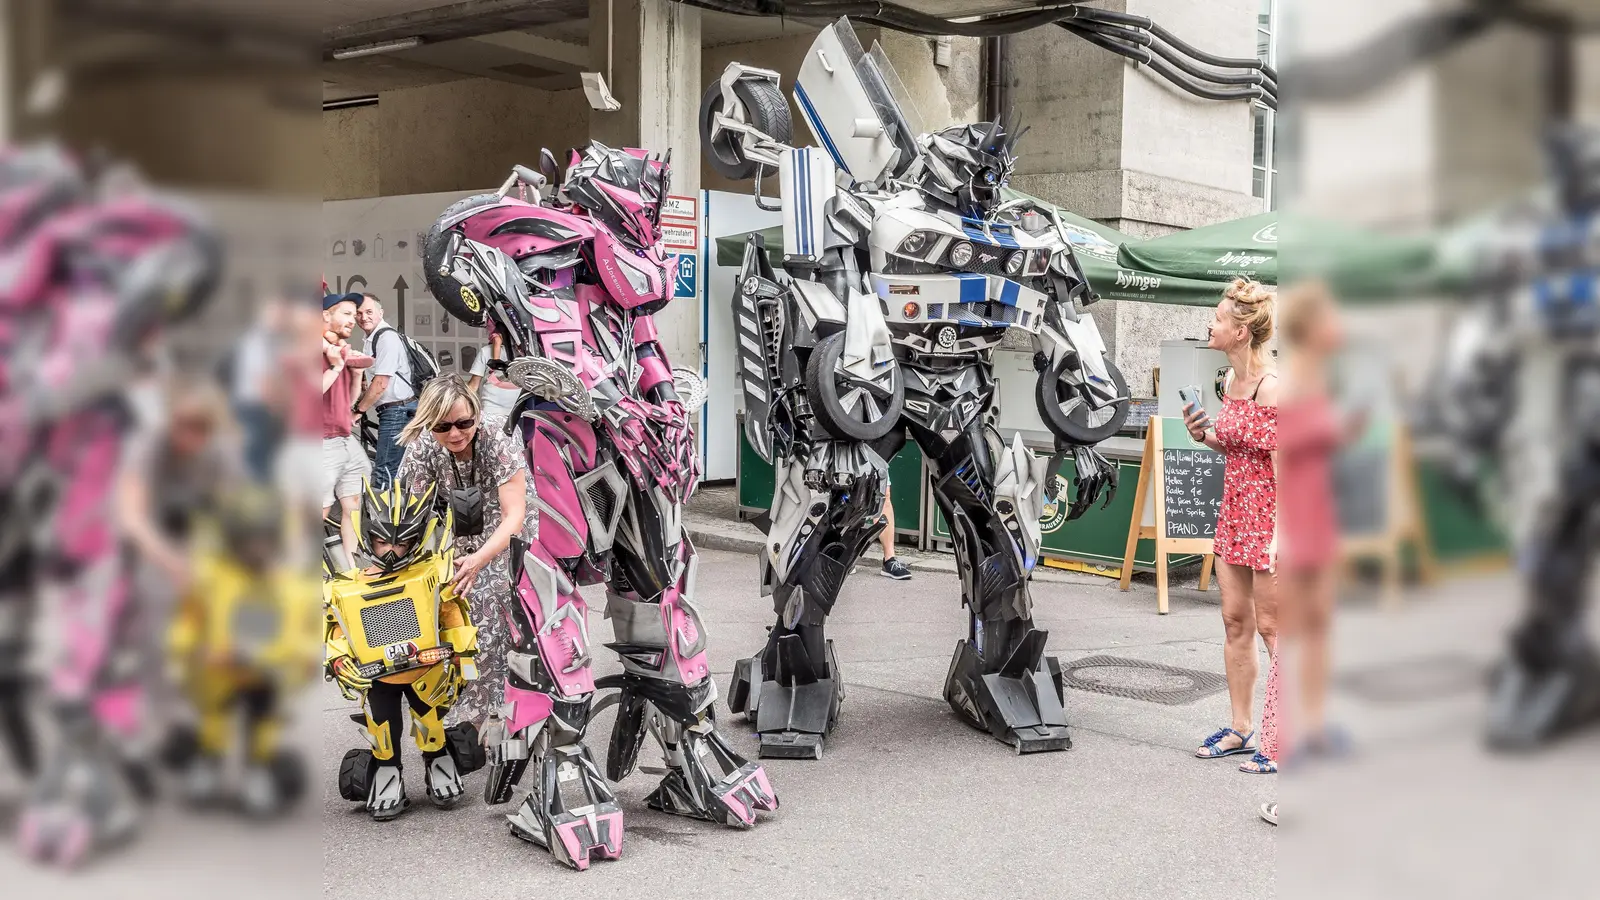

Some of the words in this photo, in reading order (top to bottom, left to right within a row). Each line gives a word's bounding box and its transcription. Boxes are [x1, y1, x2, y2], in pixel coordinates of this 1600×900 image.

[1214, 251, 1273, 268] Ayinger
[1115, 270, 1162, 291] Ayinger
[1165, 466, 1190, 475] Wasser
[1167, 522, 1198, 535] PFAND
[385, 643, 409, 660] CAT
